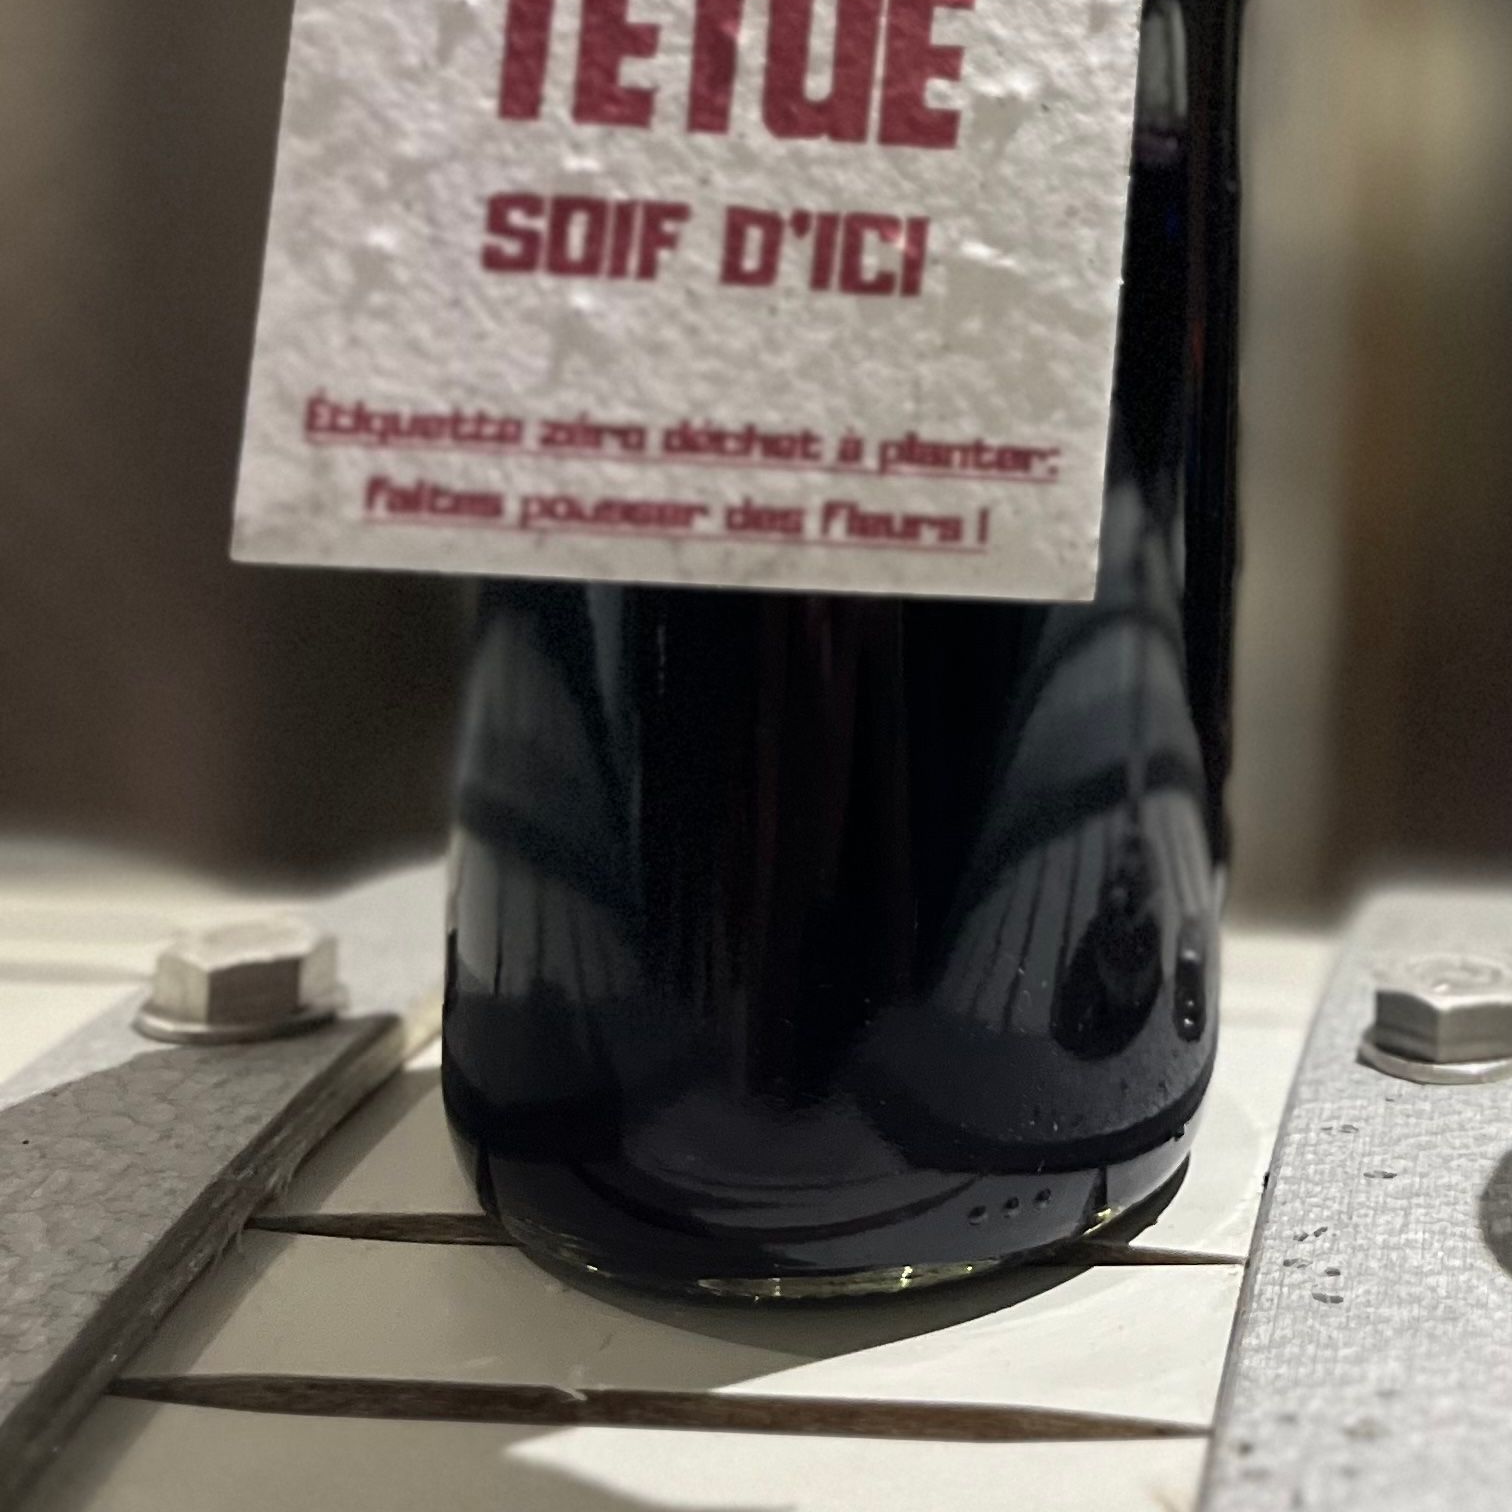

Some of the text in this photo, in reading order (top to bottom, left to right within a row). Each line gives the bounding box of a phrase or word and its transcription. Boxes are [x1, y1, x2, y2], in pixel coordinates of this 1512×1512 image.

[481, 192, 931, 299] SOIF D'ICI
[662, 417, 824, 461] déchet
[520, 493, 710, 529] pousser
[724, 496, 806, 535] des
